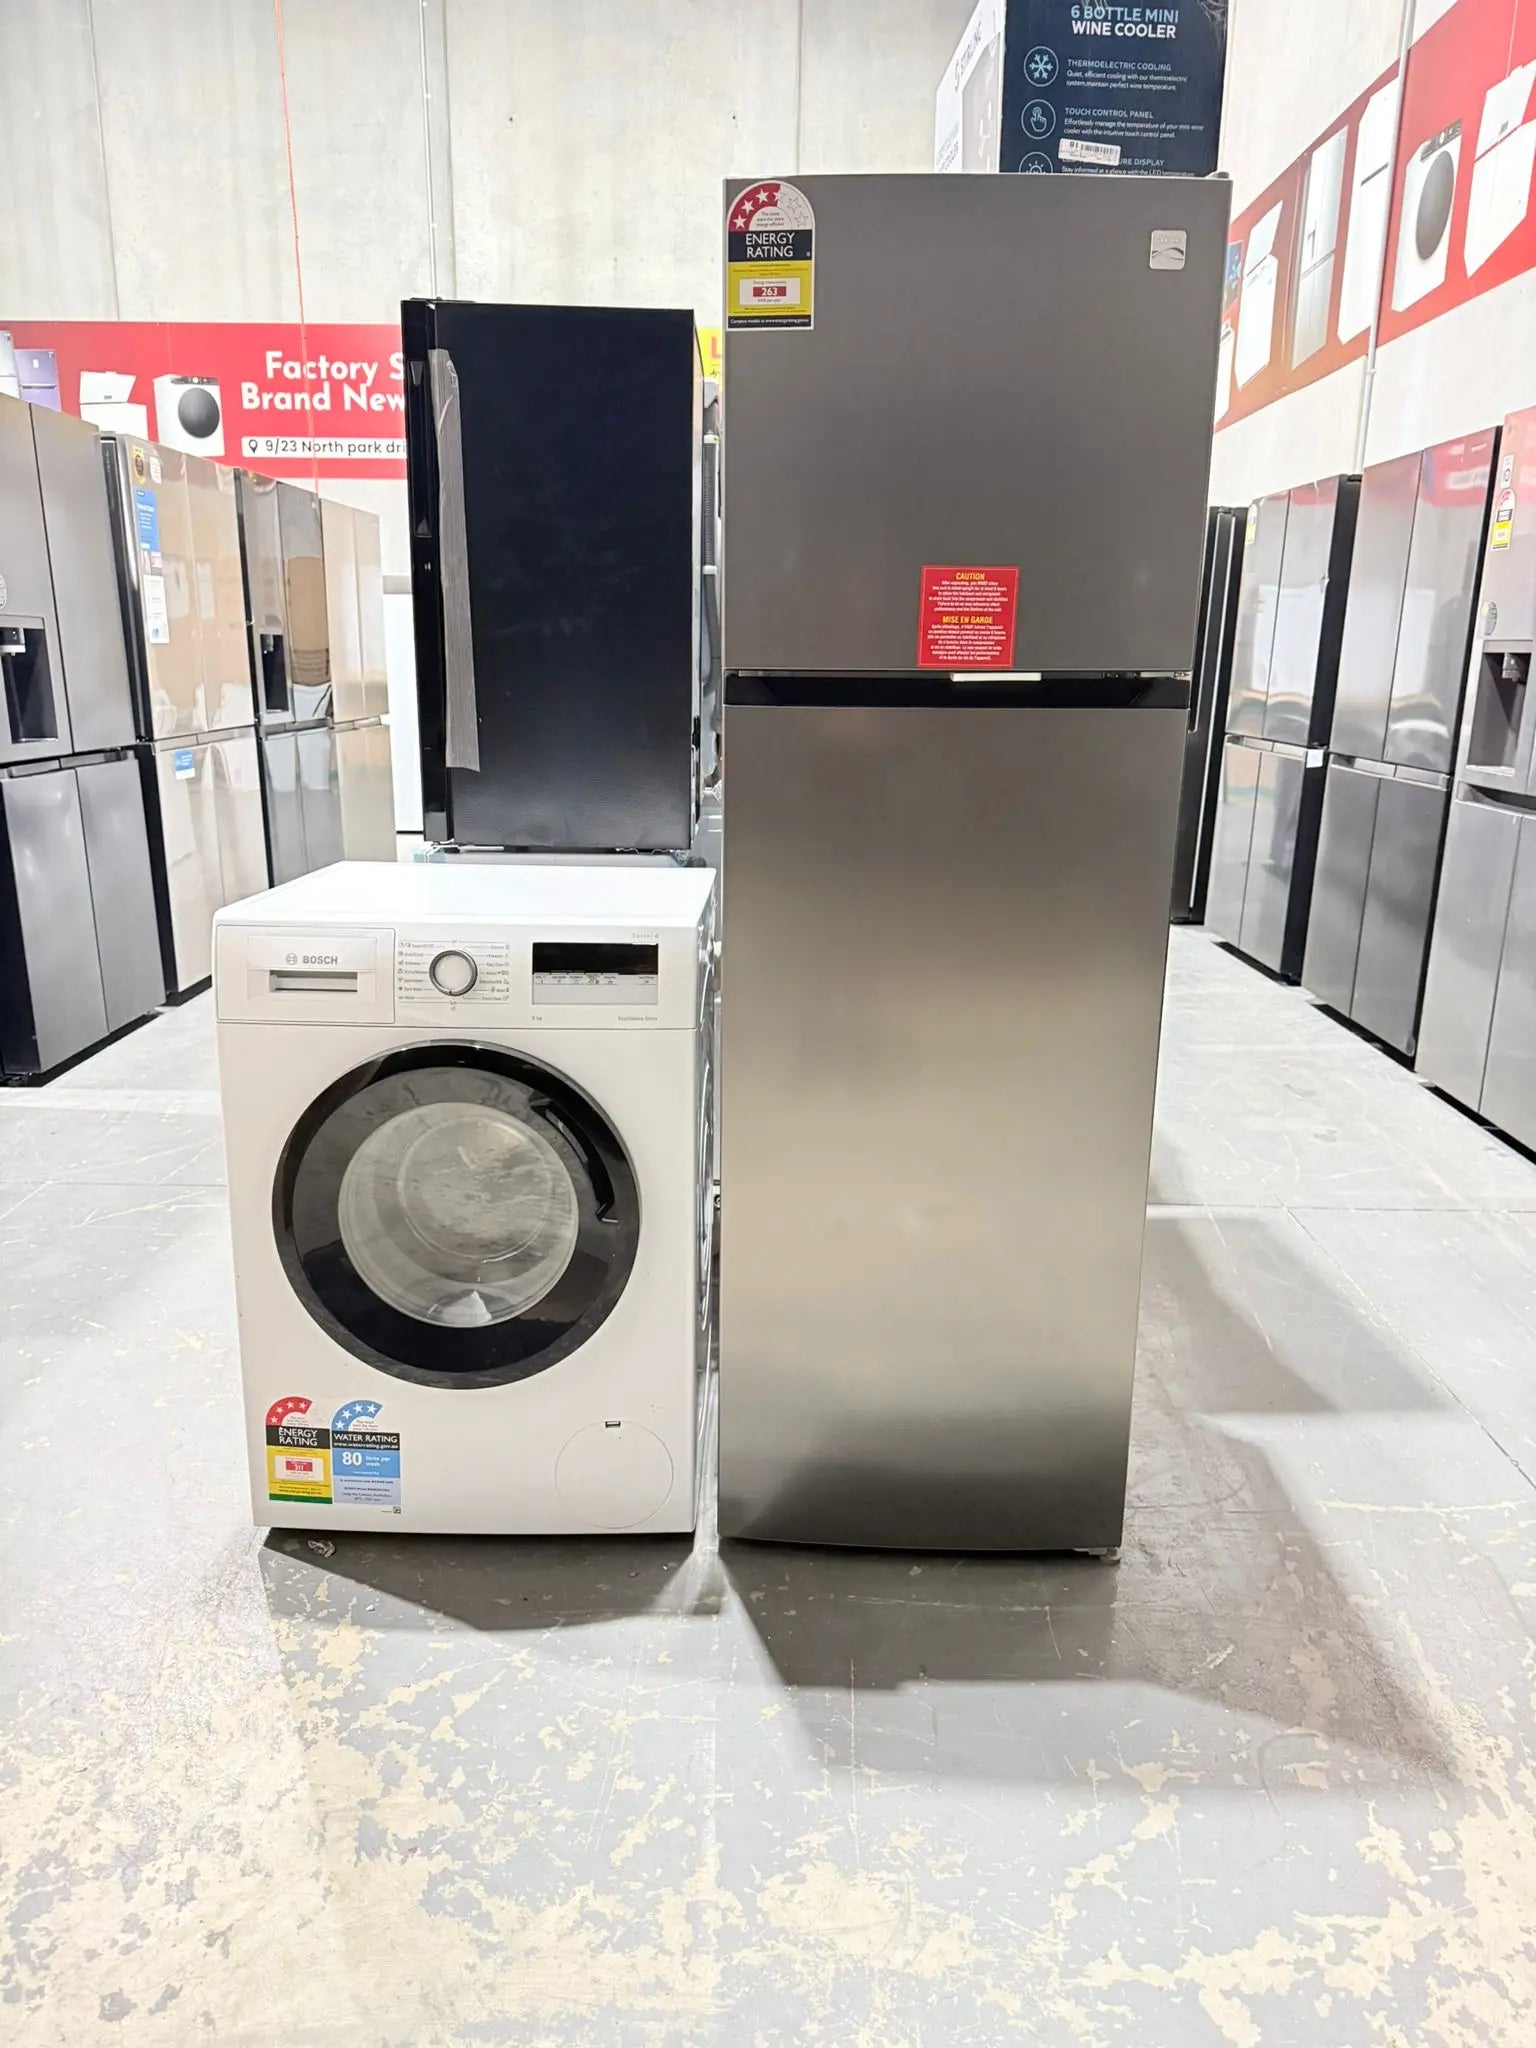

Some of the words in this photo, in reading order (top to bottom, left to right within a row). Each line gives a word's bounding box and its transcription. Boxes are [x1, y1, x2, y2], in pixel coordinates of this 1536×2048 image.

[1071, 5, 1080, 18] 6
[1084, 6, 1142, 21] BOTTLE
[1145, 9, 1179, 23] MINI
[1072, 20, 1112, 36] WINE
[1114, 23, 1176, 38] COOLER
[1067, 60, 1136, 70] THERMOELECTRIC
[1136, 62, 1172, 71] COOLING
[1066, 70, 1084, 78] Quiet,
[1084, 70, 1106, 79] efficient
[1106, 72, 1126, 80] cooling
[1149, 74, 1188, 82] thermoelectric
[1110, 81, 1130, 89] perfect
[1064, 108, 1091, 116] TOUCH
[1092, 108, 1128, 118] CONTROL
[1130, 110, 1154, 119] PANEL
[1064, 118, 1094, 127] Effortlessly
[1094, 120, 1116, 128] manage
[1126, 121, 1159, 130] temperature
[1134, 158, 1164, 166] DISPLAY
[1062, 166, 1073, 174] Stay
[746, 232, 795, 245] ENERGY
[746, 246, 794, 258] RATING
[761, 288, 778, 296] 263
[266, 351, 378, 387] Factory
[389, 352, 404, 380] S
[241, 381, 331, 411] Brand
[344, 382, 406, 412] New
[266, 438, 298, 454] 9/23
[302, 440, 344, 453] North
[348, 441, 382, 456] park
[386, 440, 406, 454] dri
[956, 572, 986, 580] CAUTION
[942, 616, 959, 624] MISE
[960, 616, 969, 624] EN
[970, 616, 994, 624] GARDE
[302, 955, 338, 965] BOSCH
[278, 1427, 318, 1438] ENERGY
[334, 1432, 363, 1442] WATER
[366, 1434, 398, 1443] RATING
[279, 1436, 318, 1446] RATING
[342, 1452, 362, 1466] 80
